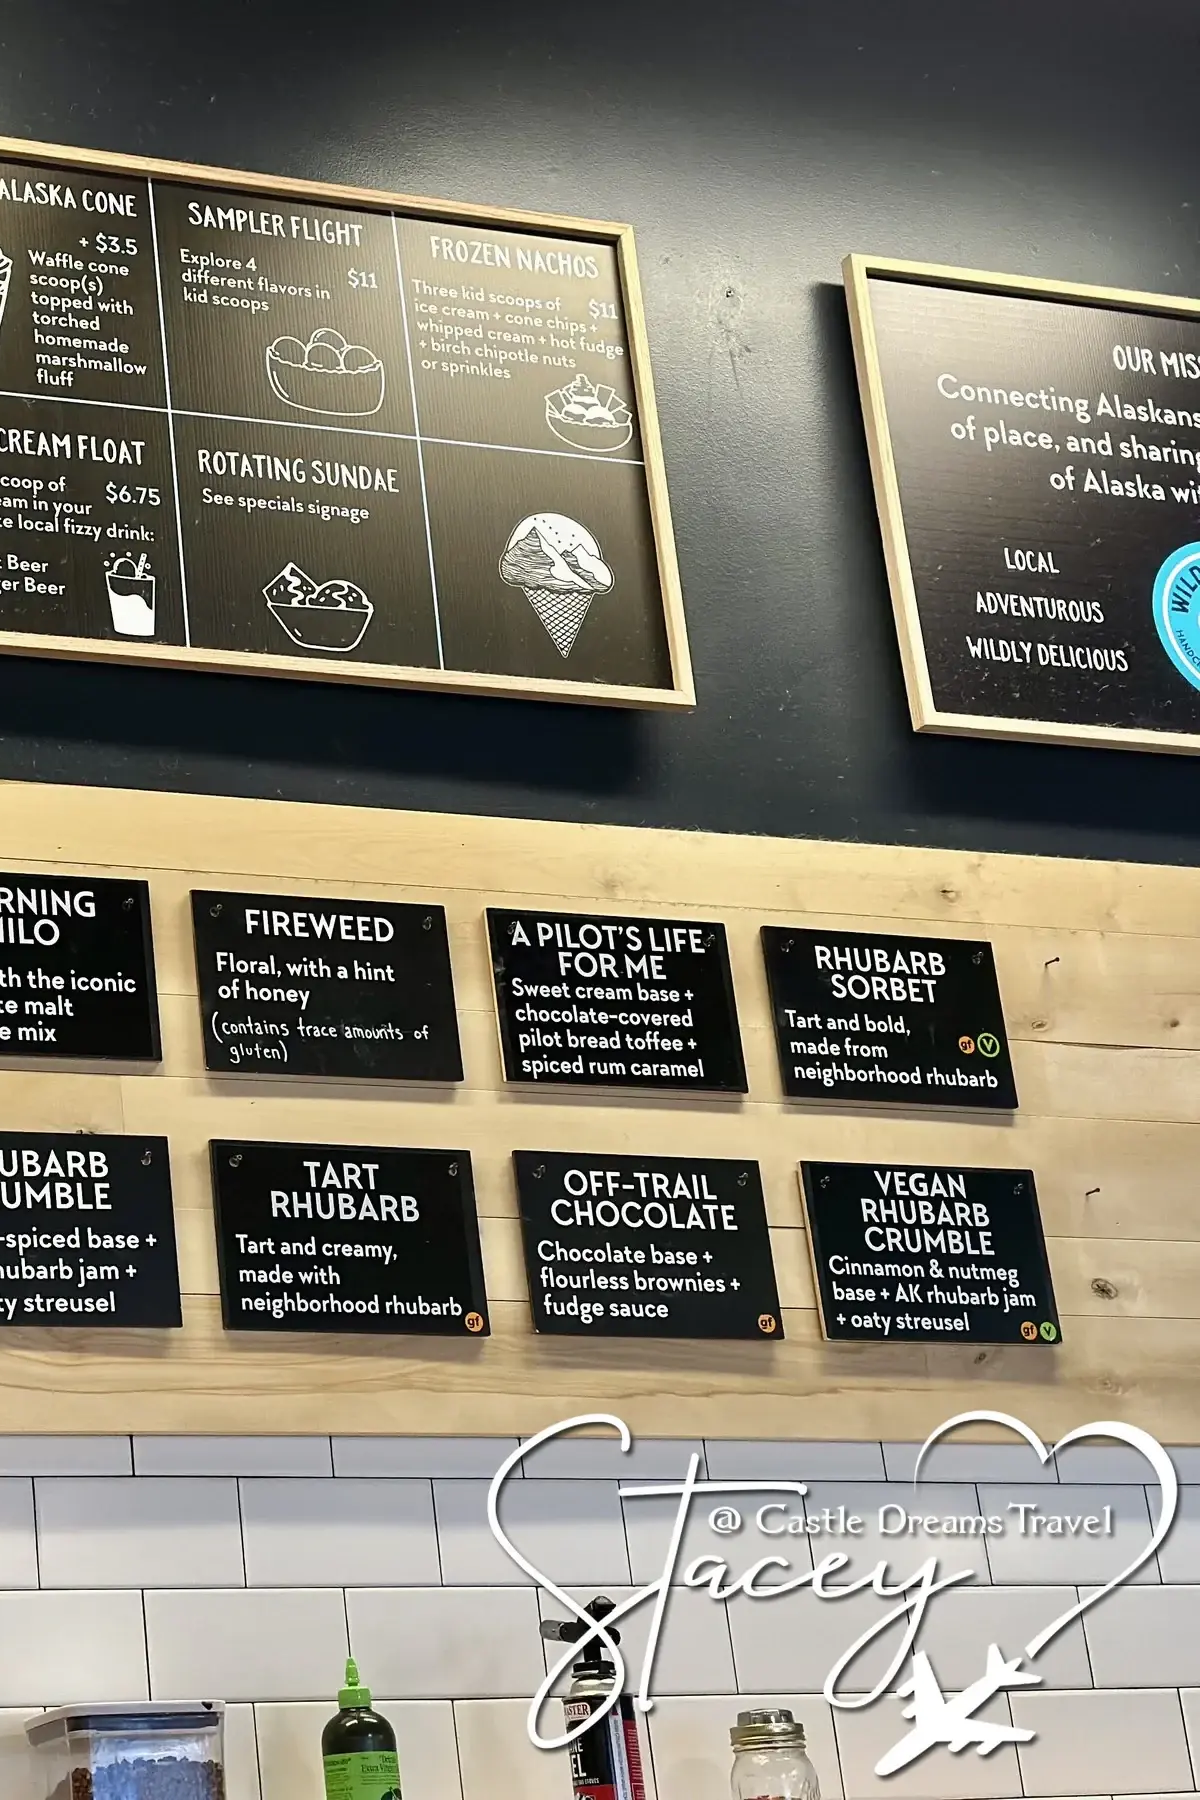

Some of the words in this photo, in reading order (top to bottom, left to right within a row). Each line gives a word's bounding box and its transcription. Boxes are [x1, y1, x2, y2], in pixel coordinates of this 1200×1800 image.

[82, 192, 137, 217] CONE
[188, 202, 286, 238] SAMPLER
[290, 216, 362, 247] FLIGHT
[430, 235, 512, 269] FROZEN
[516, 246, 599, 278] NACHOS
[29, 274, 104, 297] scoop(s)
[347, 267, 378, 289] $11
[30, 291, 93, 313] topped
[97, 298, 134, 316] with
[183, 286, 208, 304] kid
[212, 295, 270, 315] scoops
[31, 310, 100, 331] torched
[34, 328, 130, 354] homemade
[35, 352, 147, 375] marshmallow
[36, 367, 74, 387] fluff
[420, 359, 438, 370] or
[441, 359, 512, 379] sprinkles
[1113, 345, 1156, 375] OUR
[1160, 351, 1200, 379] MIS
[937, 374, 1092, 424] Connecting
[77, 434, 146, 466] FLOAT
[197, 449, 306, 484] ROTATING
[311, 460, 400, 493] SUNDAE
[1049, 464, 1076, 491] of
[1083, 467, 1166, 501] Alaska
[105, 480, 161, 506] $6.75
[202, 487, 235, 506] See
[238, 495, 304, 513] specials
[307, 499, 370, 524] signage
[17, 509, 61, 533] local
[63, 517, 102, 542] fizzy
[106, 522, 155, 542] drink:
[1003, 547, 1060, 574] LOCAL
[976, 591, 1105, 624] ADVENTUROUS
[965, 635, 1032, 664] WILDLY
[1036, 643, 1129, 672] DELICIOUS
[245, 908, 394, 942] FIREWEED
[511, 920, 532, 947] A
[648, 928, 706, 952] LIFE
[557, 951, 620, 978] FOR
[624, 953, 667, 980] ME
[814, 945, 946, 976] RHUBARB
[218, 978, 240, 999] of
[245, 979, 310, 1010] honey
[831, 973, 937, 1003] SORBET
[24, 994, 74, 1017] malt
[515, 1002, 694, 1027] chocolate-covered
[17, 1020, 57, 1042] mix
[211, 1011, 290, 1044] (contains
[296, 1016, 338, 1038] trace
[344, 1022, 404, 1041] amounts
[413, 1024, 429, 1040] of
[229, 1039, 288, 1064] gluten)
[790, 1036, 841, 1056] made
[843, 1037, 889, 1059] from
[794, 1061, 922, 1087] neighborhood
[926, 1066, 998, 1088] rhubarb
[303, 1160, 380, 1190] TART
[563, 1169, 718, 1200] OFF-TRAIL
[873, 1170, 967, 1199] VEGAN
[270, 1190, 420, 1222] RHUBARB
[550, 1198, 739, 1231] CHOCOLATE
[860, 1198, 990, 1227] RHUBARB
[864, 1226, 996, 1256] CRUMBLE
[828, 1254, 925, 1278] Cinnamon
[929, 1258, 945, 1279] &
[948, 1263, 1020, 1289] nutmeg
[23, 1290, 116, 1313] streusel
[543, 1293, 605, 1324] fudge
[609, 1303, 669, 1318] sauce
